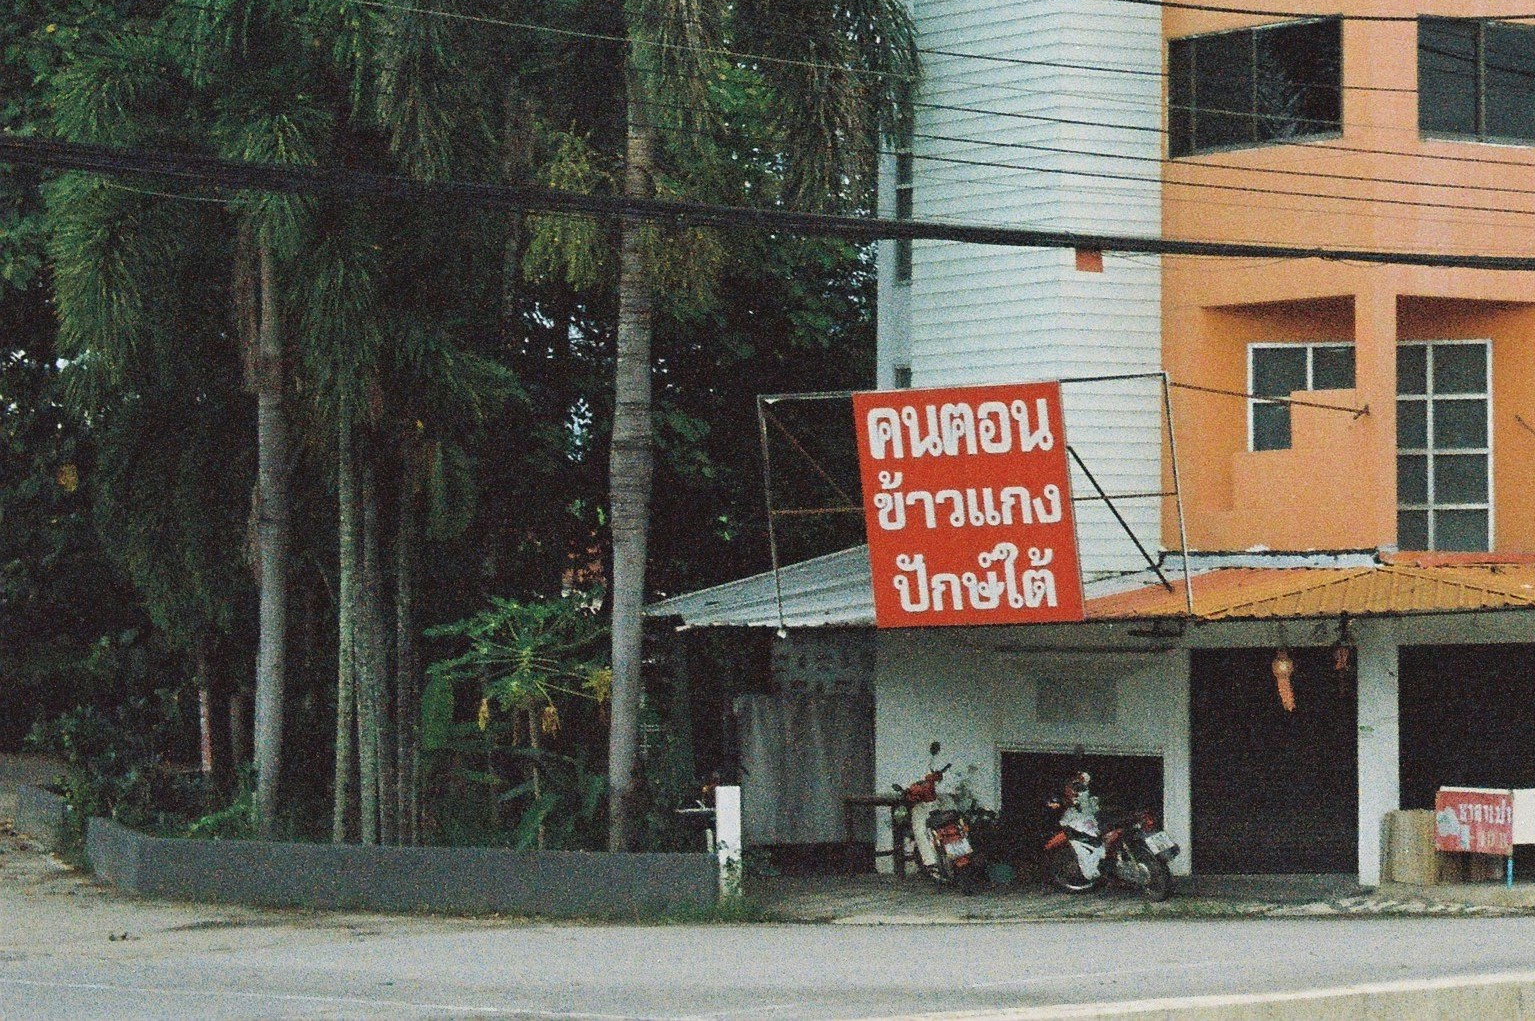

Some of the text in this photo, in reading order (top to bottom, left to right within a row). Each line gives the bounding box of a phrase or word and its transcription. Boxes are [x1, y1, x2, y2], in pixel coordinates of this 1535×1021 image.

[873, 470, 1062, 531] ข้าวแกง
[893, 542, 1058, 612] ปักษ์ใต้
